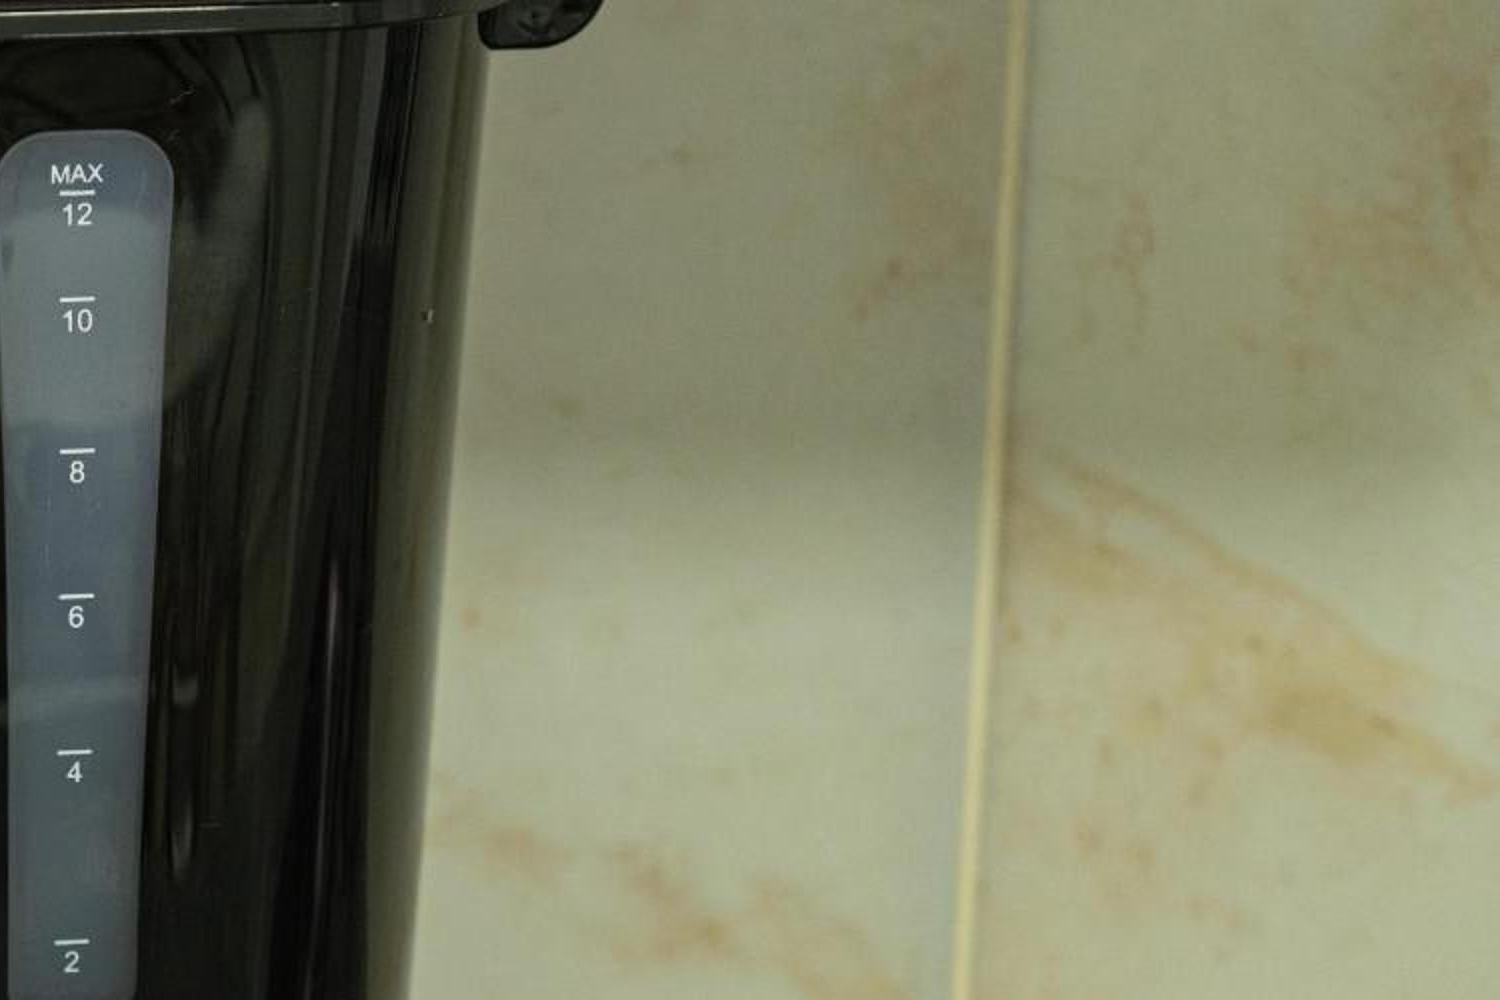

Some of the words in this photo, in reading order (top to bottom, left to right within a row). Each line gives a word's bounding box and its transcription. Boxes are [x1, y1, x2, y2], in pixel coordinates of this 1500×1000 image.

[50, 162, 104, 185] MAX
[62, 202, 93, 227] 12
[62, 308, 94, 333] 10
[68, 459, 86, 484] 8
[67, 604, 85, 629] 6
[65, 760, 84, 784] 4
[63, 949, 80, 974] 2
